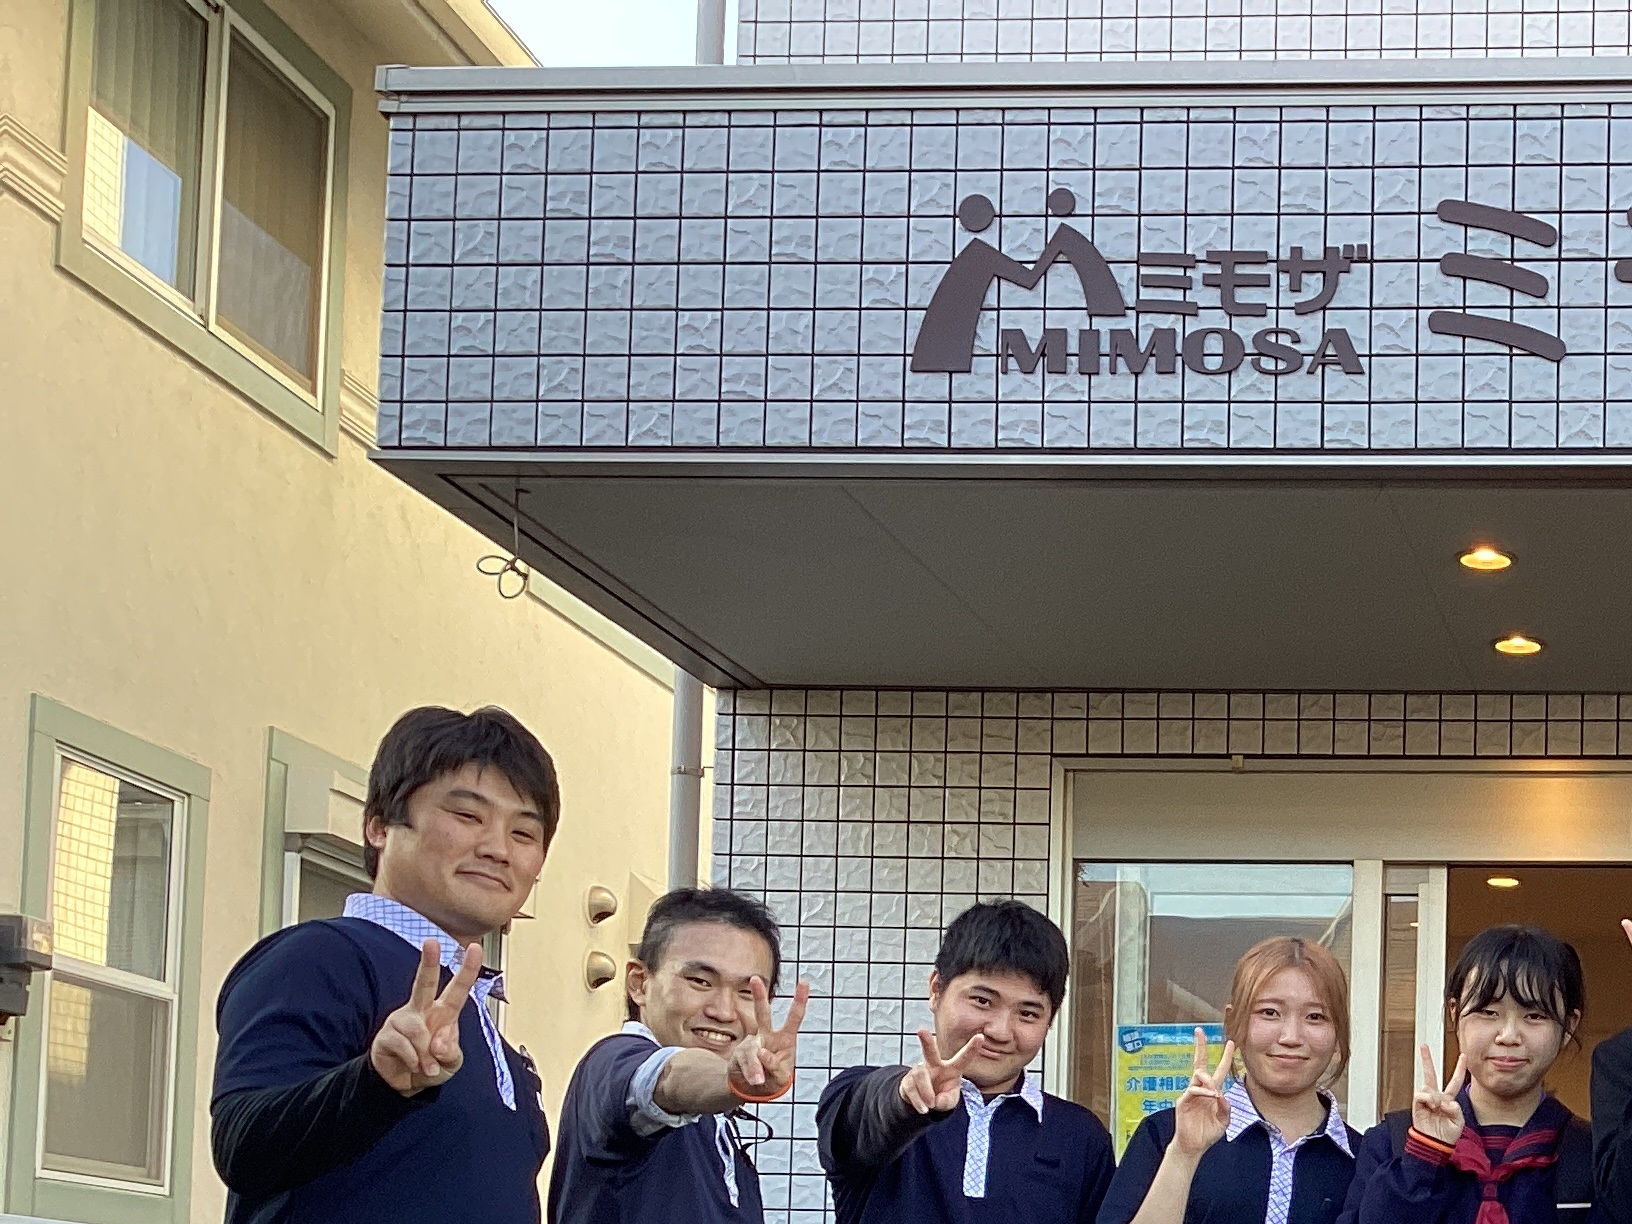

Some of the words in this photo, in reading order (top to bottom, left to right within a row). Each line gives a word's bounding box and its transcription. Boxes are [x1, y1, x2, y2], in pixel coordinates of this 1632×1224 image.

[1135, 244, 1369, 317] ミモザ
[1000, 327, 1366, 376] MIMOSA
[1126, 1075, 1190, 1092] 介護相談
[1143, 1099, 1173, 1113] 年中
